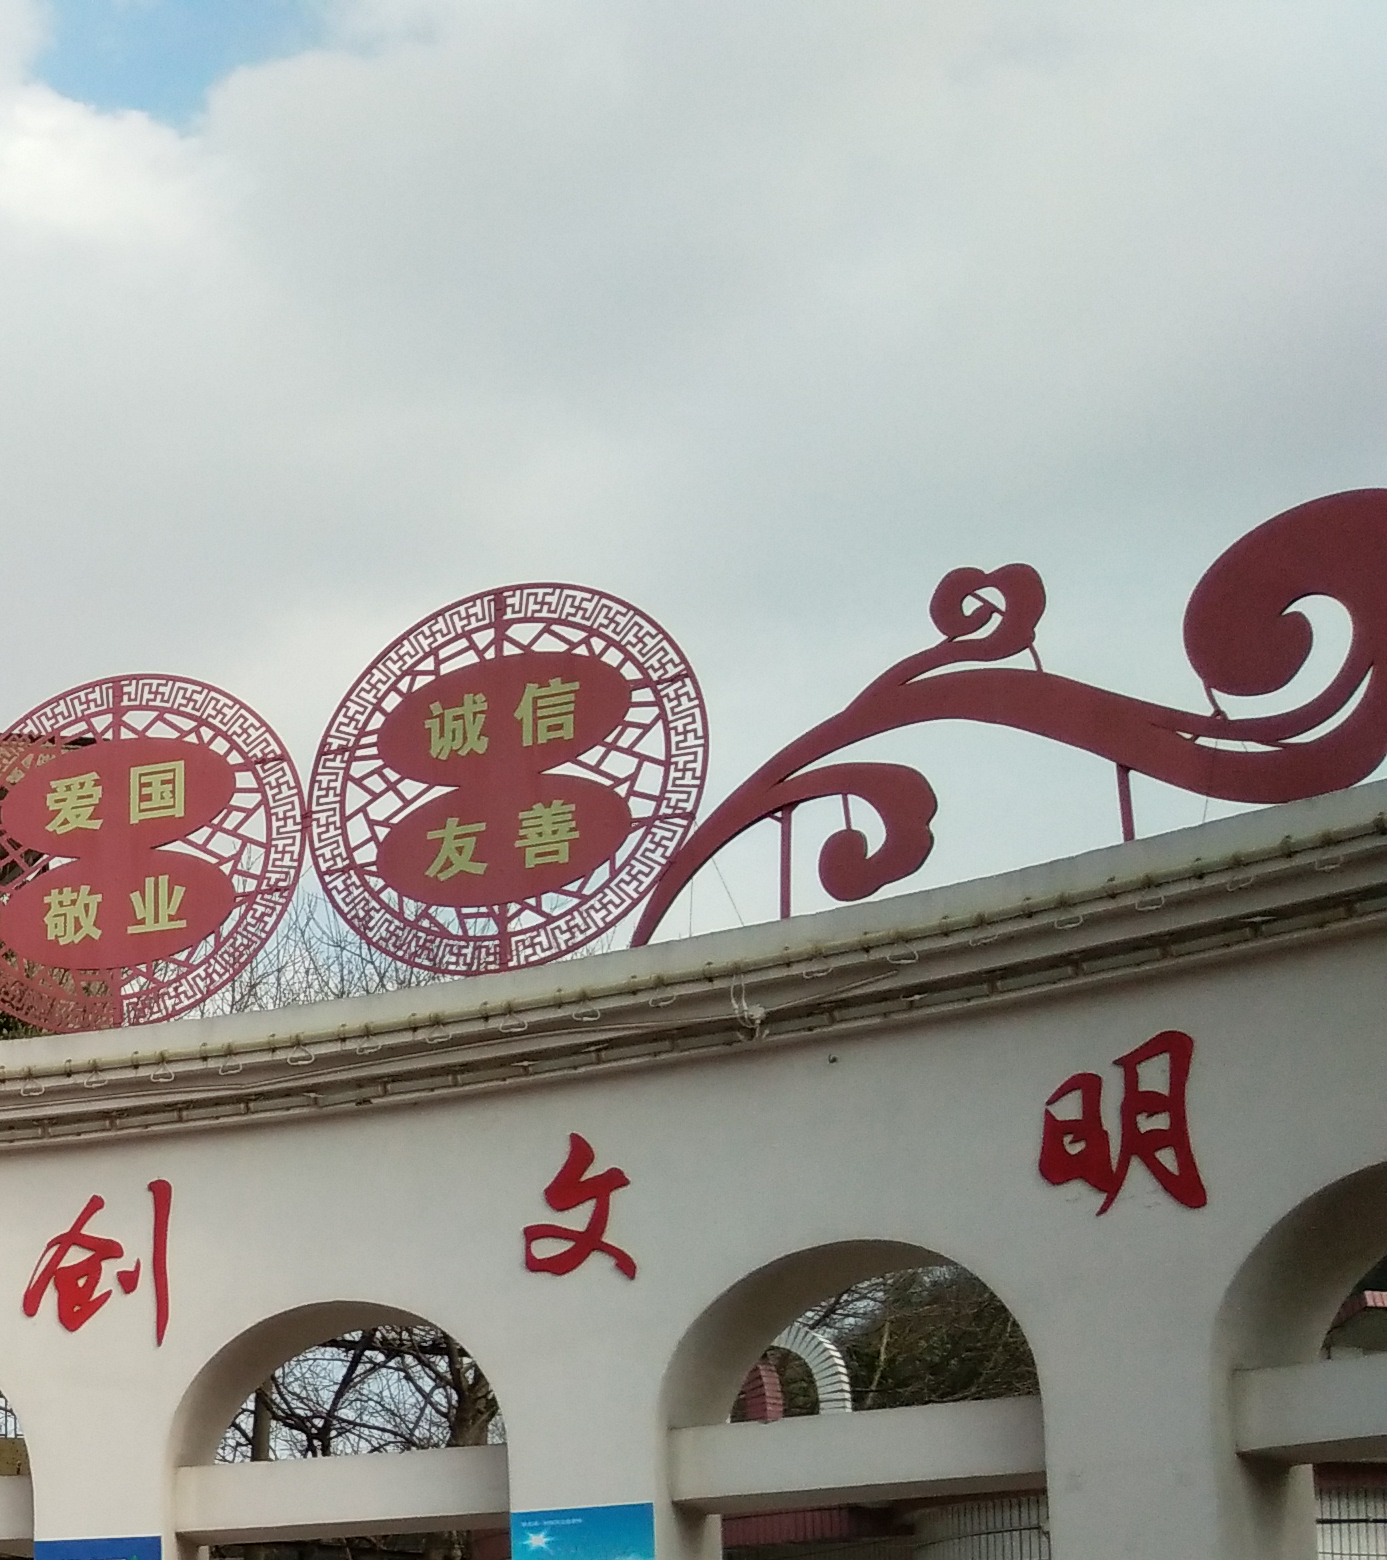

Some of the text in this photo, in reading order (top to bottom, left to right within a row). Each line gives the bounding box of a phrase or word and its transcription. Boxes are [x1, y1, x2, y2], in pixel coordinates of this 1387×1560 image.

[424, 678, 581, 760] 诚信
[45, 761, 185, 834] 爱国
[424, 800, 580, 881] 友善
[43, 875, 187, 945] 敬业
